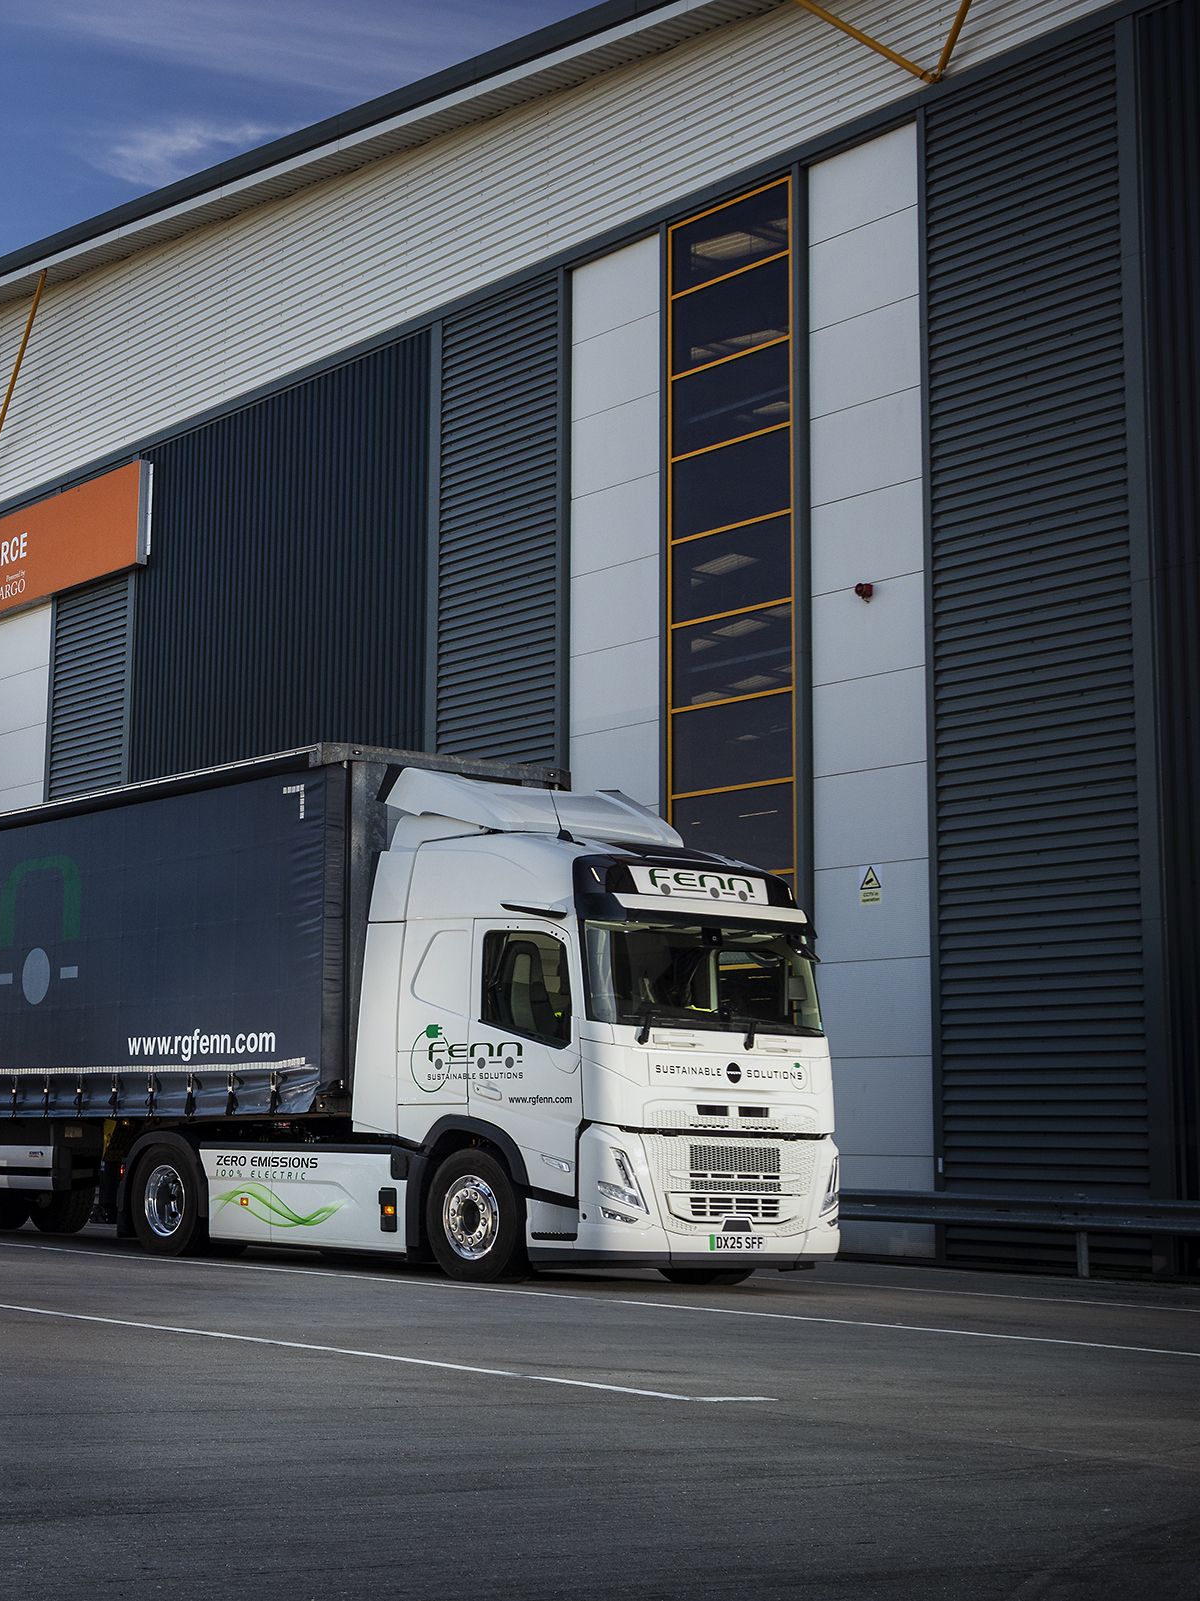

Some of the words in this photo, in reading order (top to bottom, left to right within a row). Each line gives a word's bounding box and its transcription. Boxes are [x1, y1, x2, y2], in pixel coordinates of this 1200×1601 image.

[127, 1028, 276, 1062] www.rgfenn.com
[427, 1073, 476, 1081] SUSTAINABLE
[479, 1071, 524, 1080] SOLUTIONS
[655, 1064, 722, 1077] SUSTAINABLE
[746, 1069, 803, 1081] SOLUTIONS
[508, 1095, 573, 1106] www.rgfenn.com
[216, 1155, 247, 1167] ZERO
[250, 1156, 318, 1169] EMISSIONS
[215, 1169, 243, 1178] 100%
[250, 1170, 306, 1181] ELECTRIC
[716, 1236, 743, 1249] DX25
[744, 1236, 764, 1249] SFF
